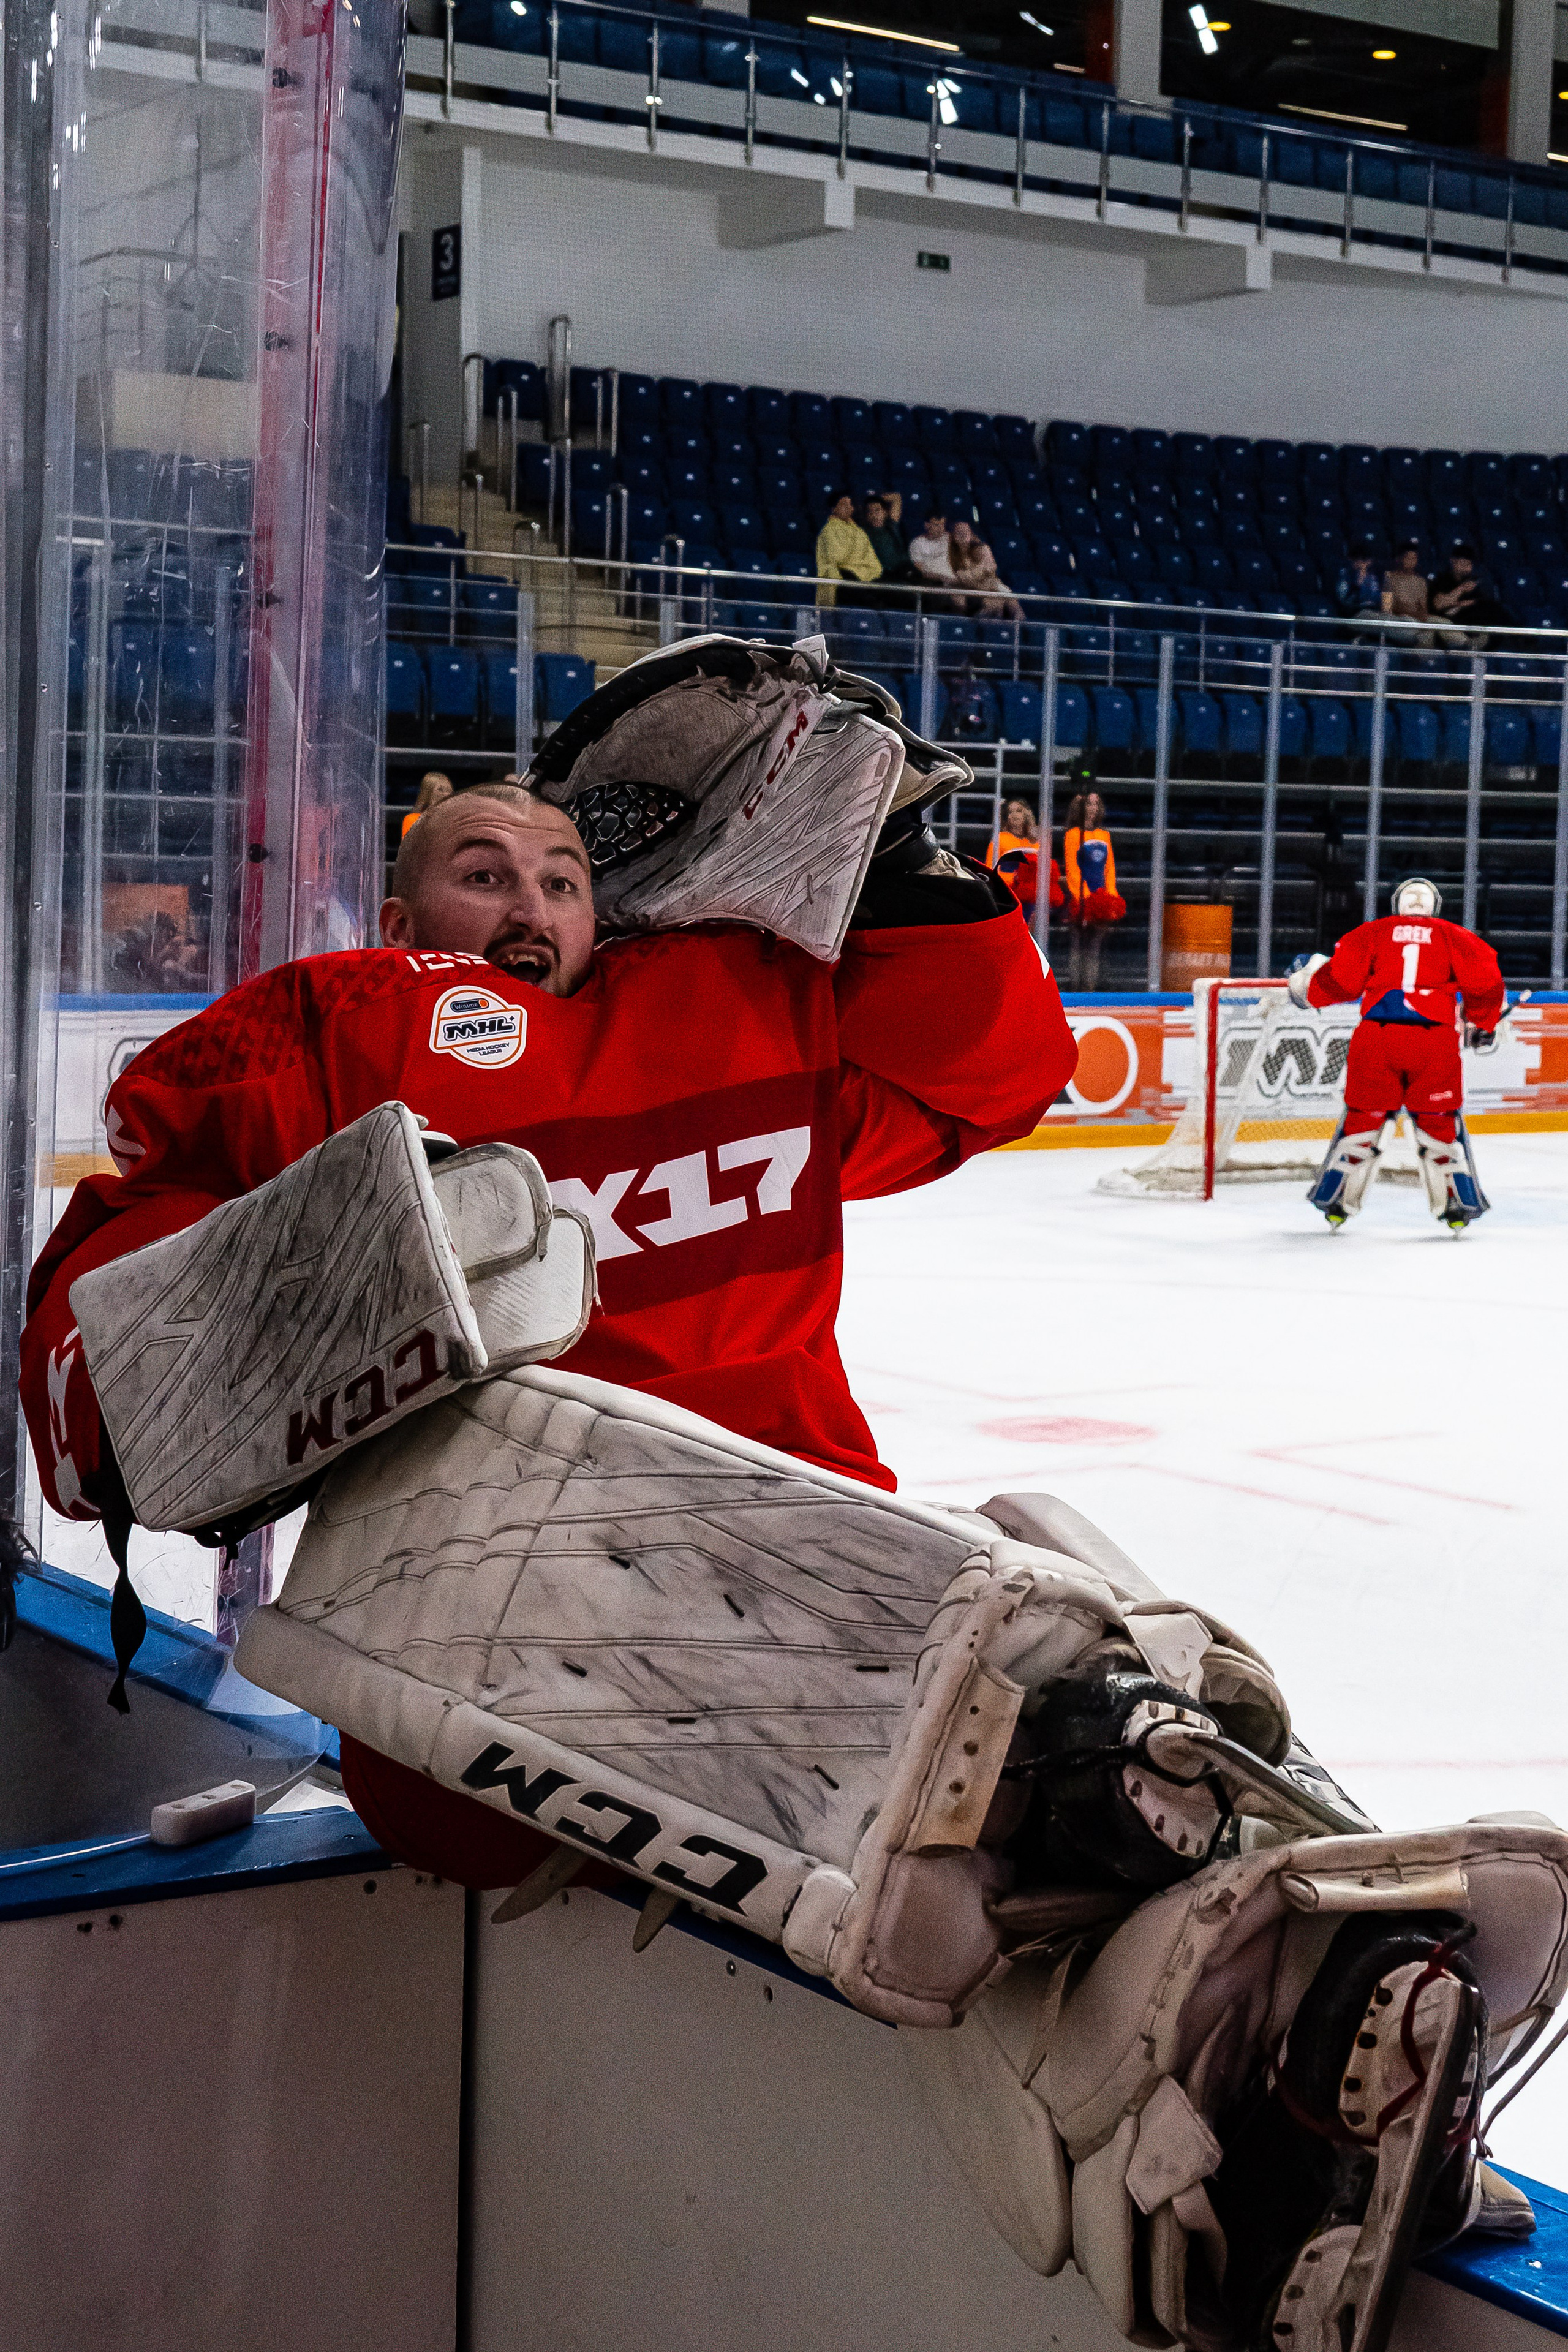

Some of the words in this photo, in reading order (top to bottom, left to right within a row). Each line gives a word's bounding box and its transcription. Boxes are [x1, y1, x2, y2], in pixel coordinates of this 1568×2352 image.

[440, 233, 453, 270] 3
[744, 708, 809, 821] CCM
[1402, 944, 1420, 993] 1
[445, 1017, 513, 1040] MHL
[288, 1328, 447, 1466] CCM
[461, 1741, 768, 1916] CCM
